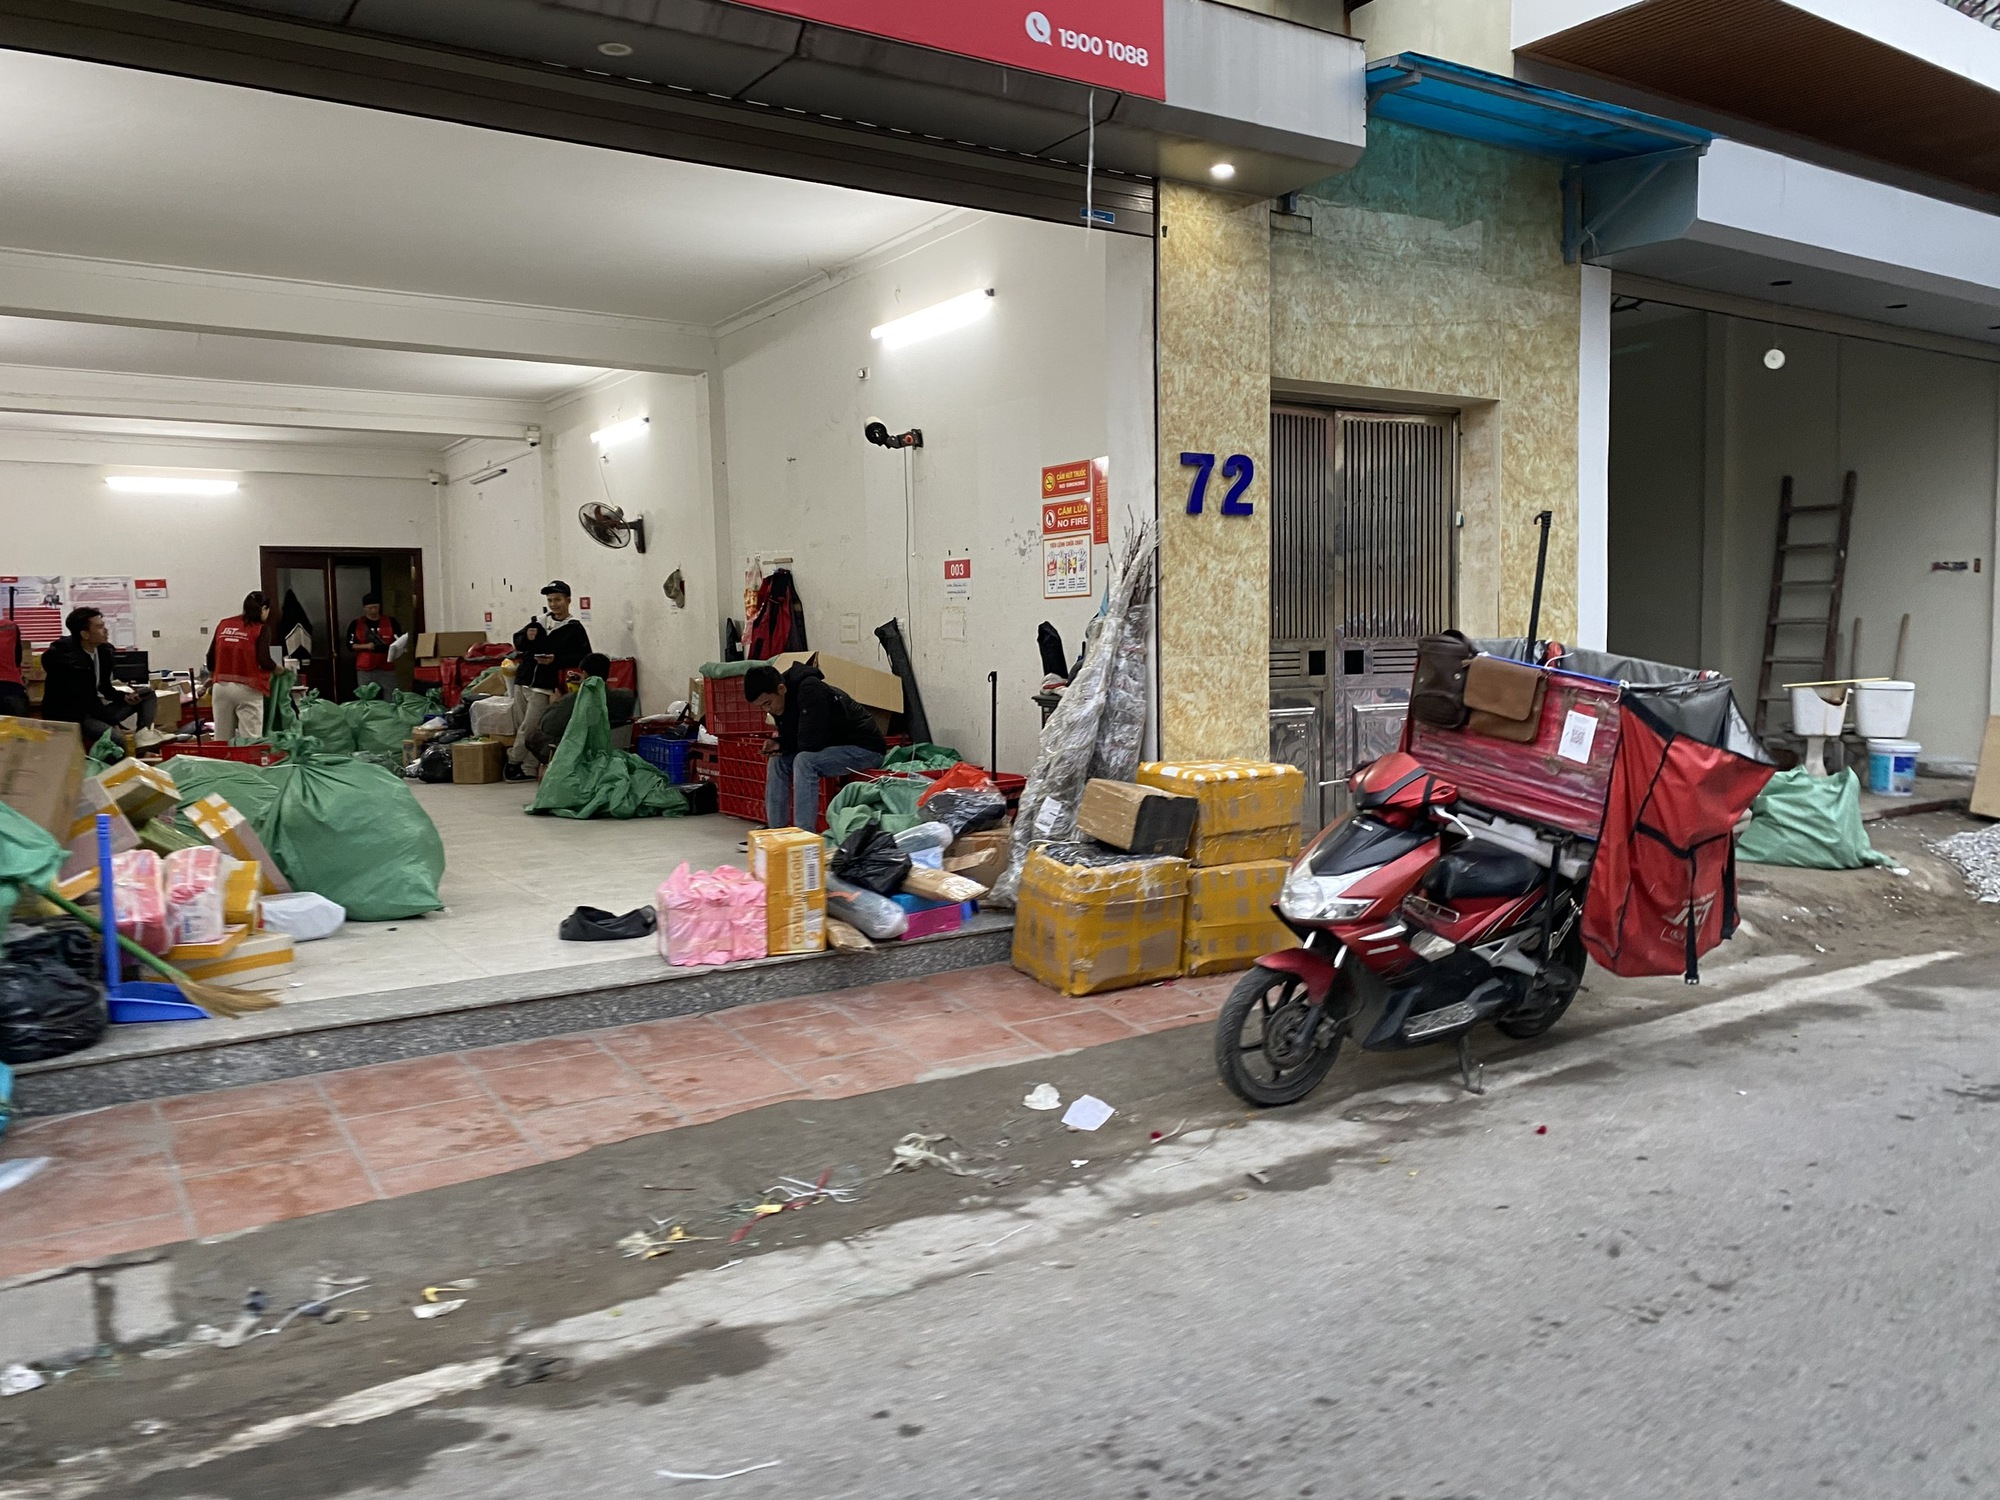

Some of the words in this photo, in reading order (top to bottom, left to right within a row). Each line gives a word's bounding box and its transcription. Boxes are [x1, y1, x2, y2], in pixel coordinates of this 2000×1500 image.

[1058, 28, 1103, 55] 1900
[1105, 39, 1149, 67] 1088
[1180, 452, 1254, 516] 72
[1057, 519, 1069, 528] NO
[1070, 516, 1088, 526] FIRE
[950, 563, 965, 576] 003
